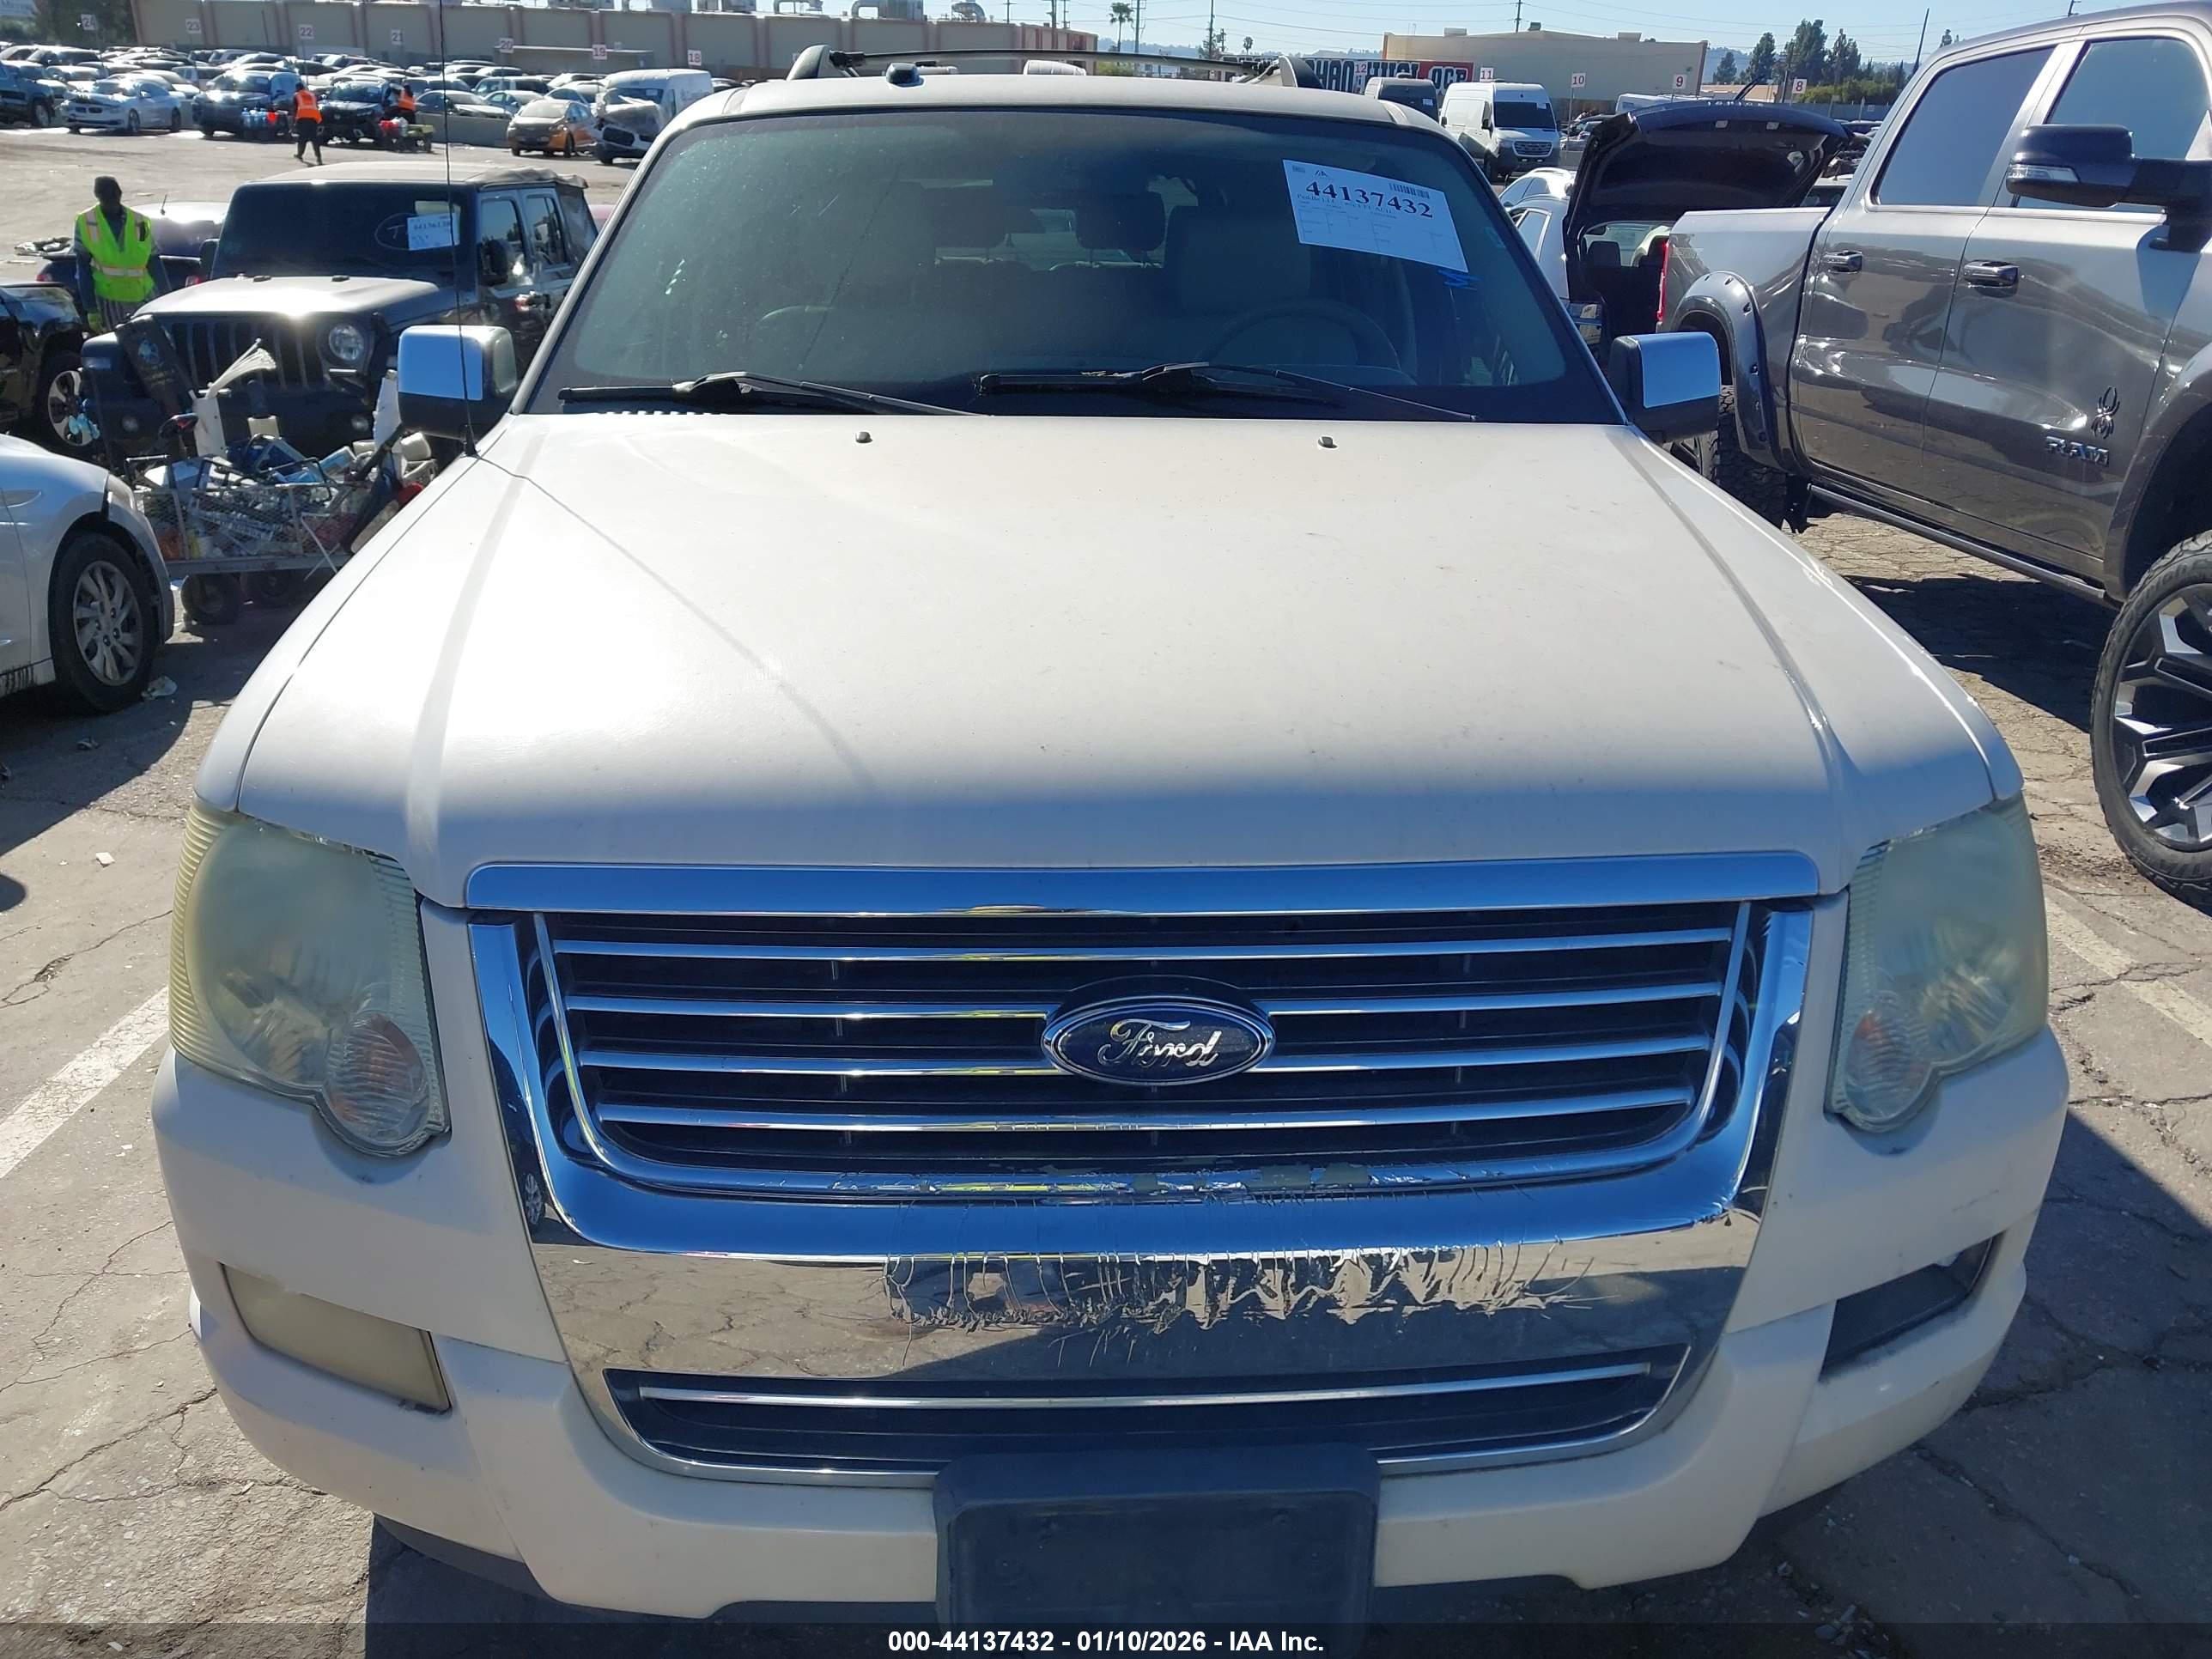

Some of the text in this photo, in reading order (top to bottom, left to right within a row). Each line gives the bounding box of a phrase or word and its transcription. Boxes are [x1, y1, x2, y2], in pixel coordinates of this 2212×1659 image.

[82, 17, 96, 27] 24
[187, 21, 200, 31] 23
[300, 27, 313, 36] 22
[392, 32, 403, 42] 21
[501, 40, 513, 50] 20
[593, 46, 606, 57] 19
[689, 53, 701, 63] 18
[1355, 64, 1367, 73] 12
[1481, 70, 1493, 80] 11
[1572, 75, 1584, 85] 10
[1675, 77, 1684, 87] 9
[1796, 82, 1803, 91] 8
[1306, 181, 1433, 218] 44137432
[1097, 1018, 1222, 1067] Ford
